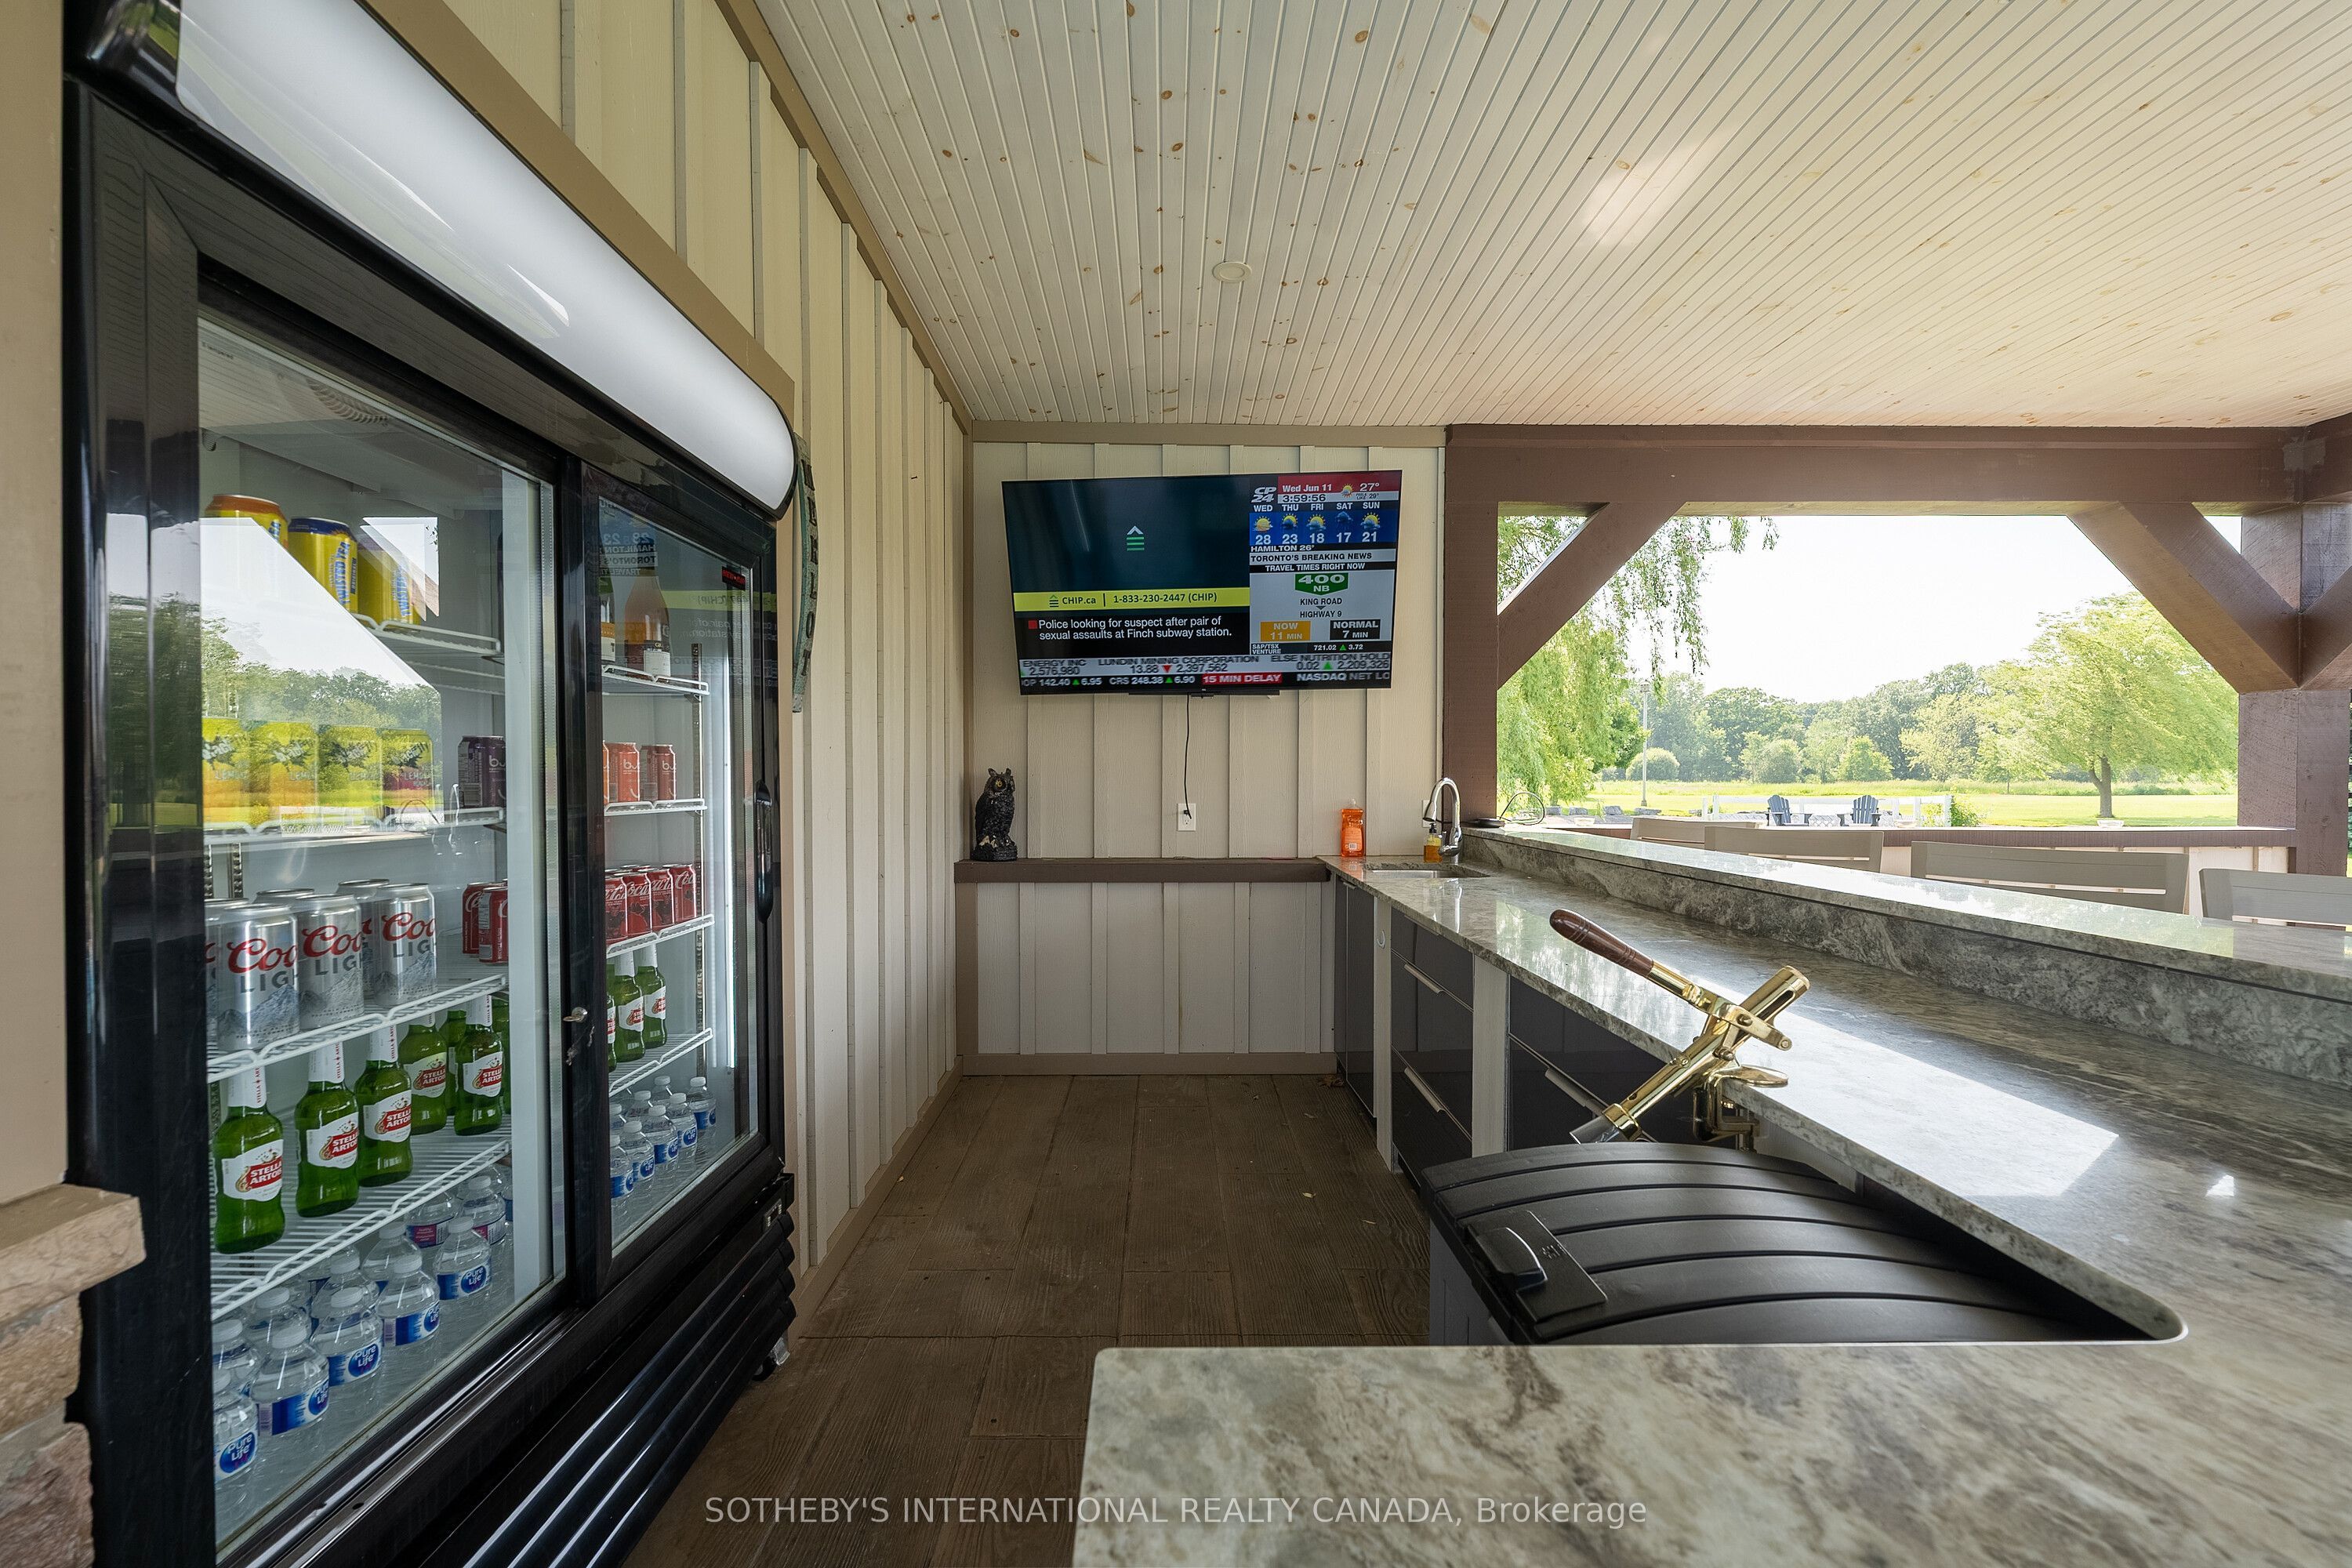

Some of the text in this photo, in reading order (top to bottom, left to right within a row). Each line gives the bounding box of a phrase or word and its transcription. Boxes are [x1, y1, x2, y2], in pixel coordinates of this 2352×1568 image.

[1250, 494, 1274, 503] 24
[1283, 494, 1326, 503] 3:59:56
[1255, 535, 1271, 545] 28
[1282, 534, 1298, 544] 23
[1310, 533, 1324, 543] 18
[1337, 532, 1351, 543] 17
[1362, 532, 1377, 542] 21
[1298, 574, 1345, 584] 400
[1113, 593, 1185, 603] 1-833-230-2447
[1189, 593, 1217, 603] (CHIP)
[1039, 615, 1221, 630] Police looking for suspect after pair of
[1040, 630, 1070, 640] sexual
[1073, 630, 1112, 639] assaults
[1127, 628, 1153, 638] Finch
[1156, 628, 1193, 639] subway
[1196, 627, 1232, 637] station.
[1181, 655, 1259, 664] CORPORATION
[1297, 662, 1319, 670] 0.02
[1296, 673, 1347, 681] NASDAQ
[355, 1345, 376, 1360] Pure
[358, 1355, 374, 1367] Life
[227, 1434, 252, 1450] Pure
[231, 1444, 249, 1461] Life
